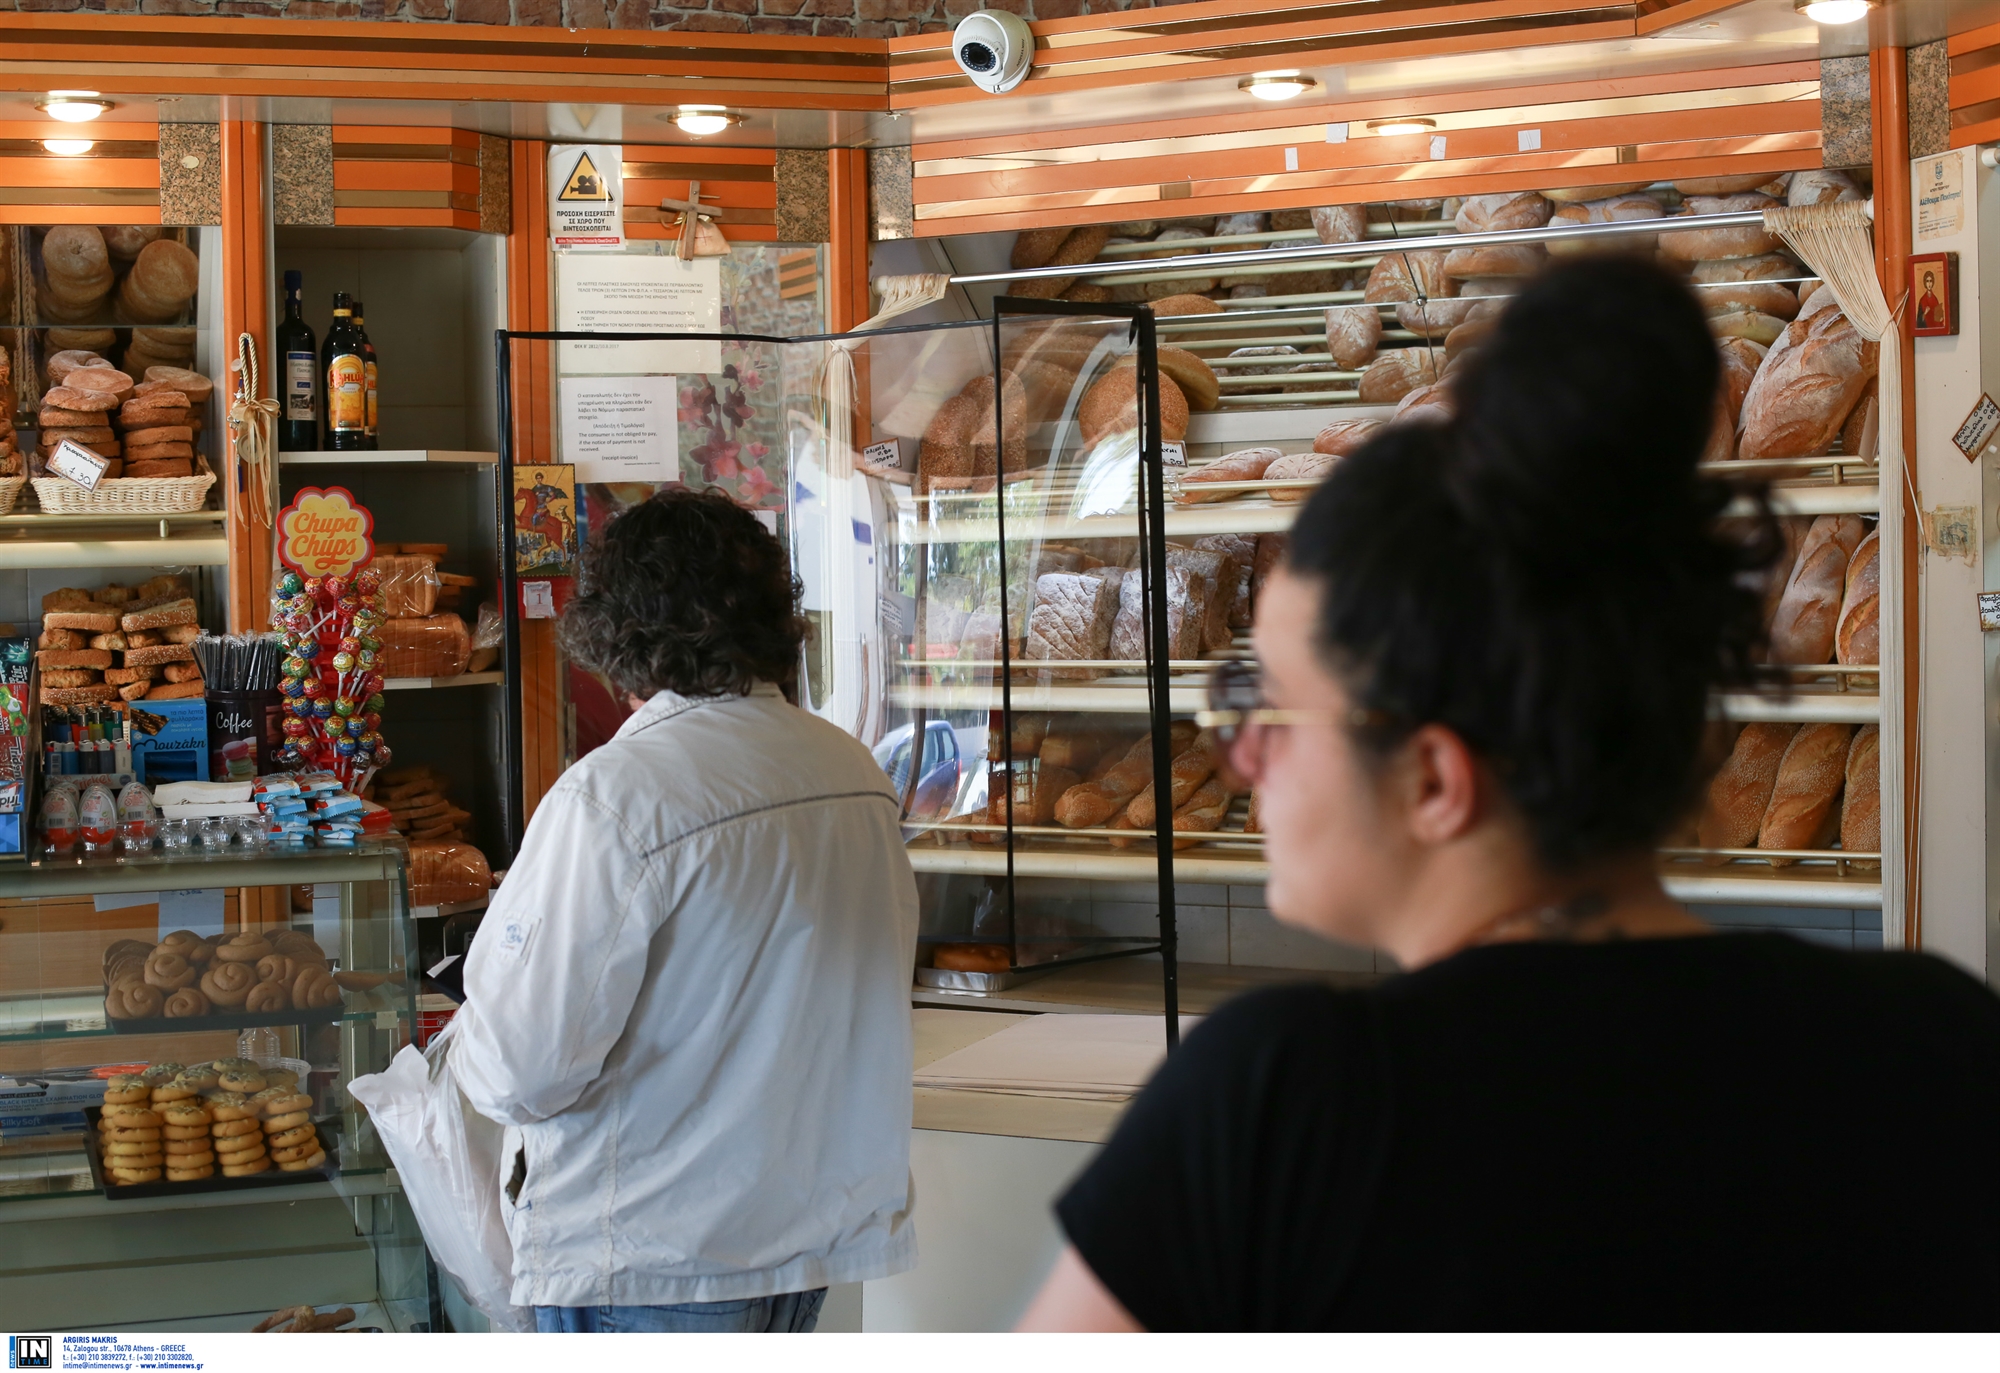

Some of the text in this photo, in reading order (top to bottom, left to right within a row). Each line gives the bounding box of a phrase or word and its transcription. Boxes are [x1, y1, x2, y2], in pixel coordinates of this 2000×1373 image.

[294, 512, 359, 538] Chupa
[292, 535, 357, 570] Chups
[537, 593, 542, 604] 1
[216, 711, 253, 733] Coffee
